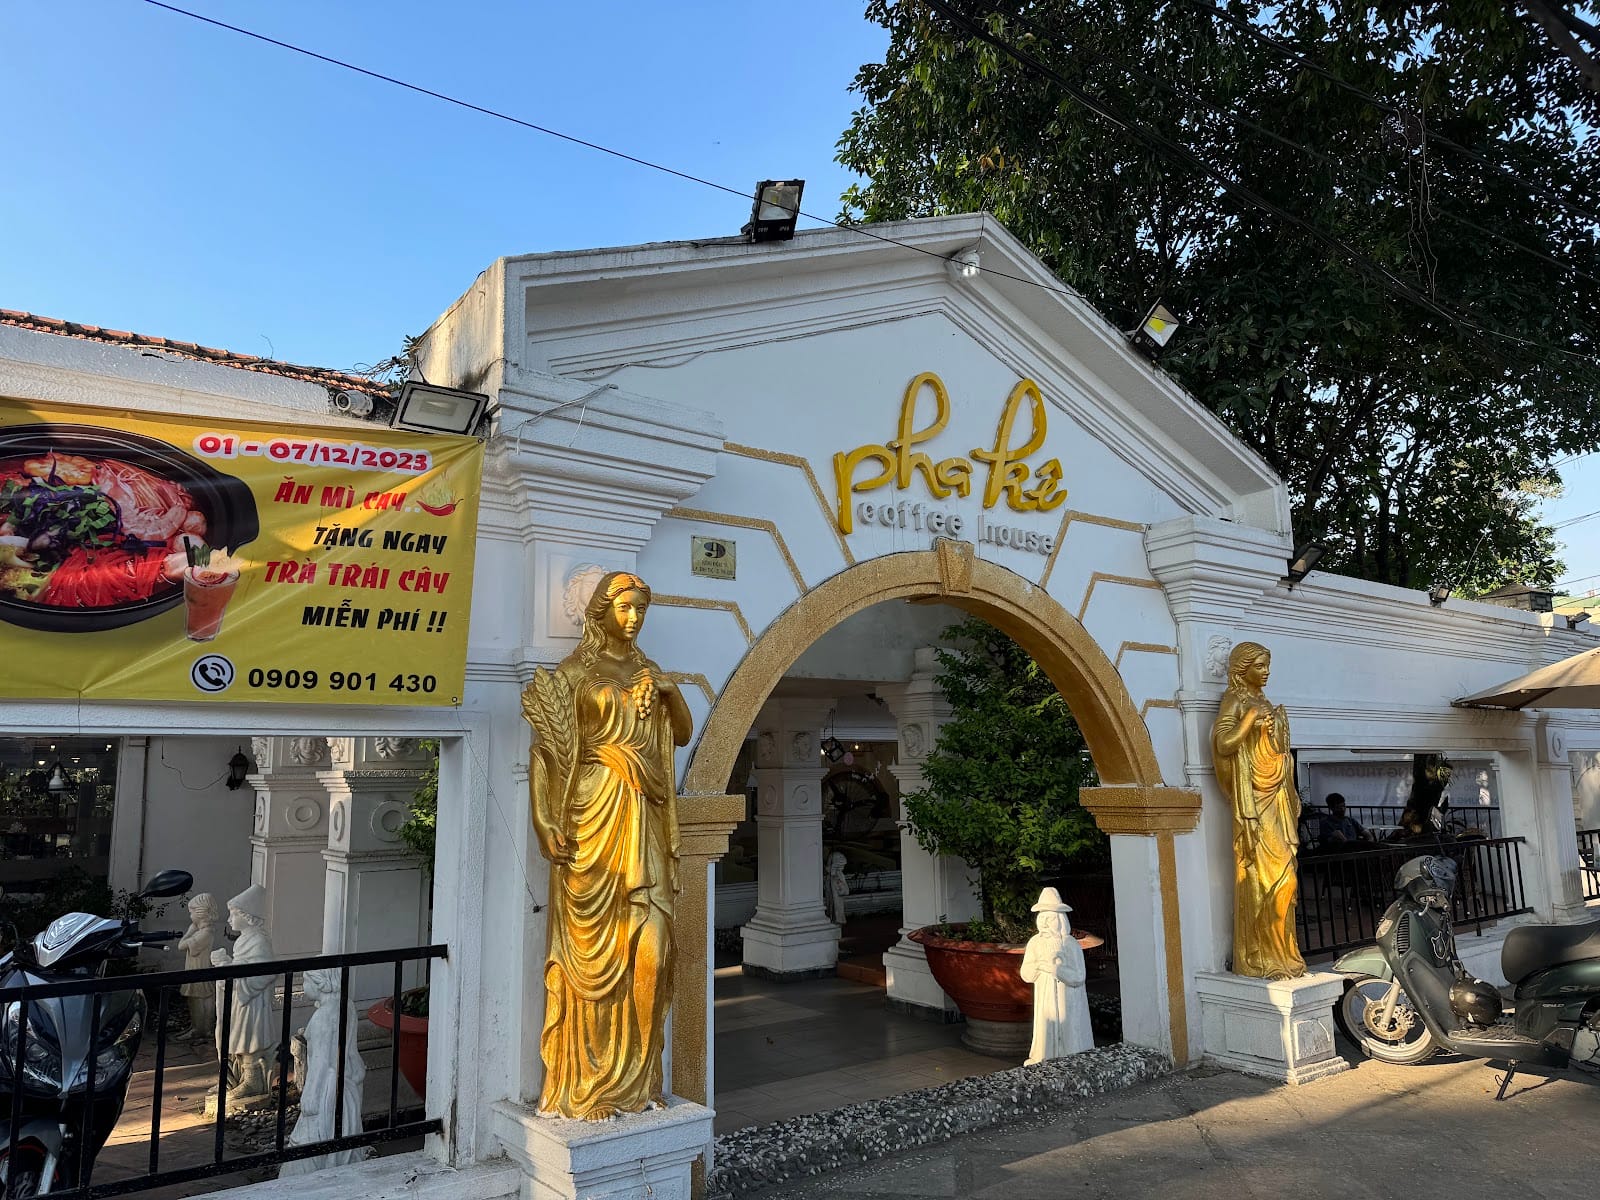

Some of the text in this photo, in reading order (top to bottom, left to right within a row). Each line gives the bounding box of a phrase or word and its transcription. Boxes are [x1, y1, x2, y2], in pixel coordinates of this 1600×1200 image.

[199, 436, 234, 455] 01
[269, 441, 428, 471] 07/12/2023
[274, 476, 314, 505] ĂN
[320, 485, 355, 509] MÌ
[313, 523, 448, 555] TẶNG NGAY
[857, 500, 1056, 555] coffee house
[264, 557, 450, 594] TRÀ TRÁI CÂY
[301, 599, 370, 629] MIỄN
[376, 608, 421, 632] PHÍ
[248, 668, 437, 693] 0909 901 430
